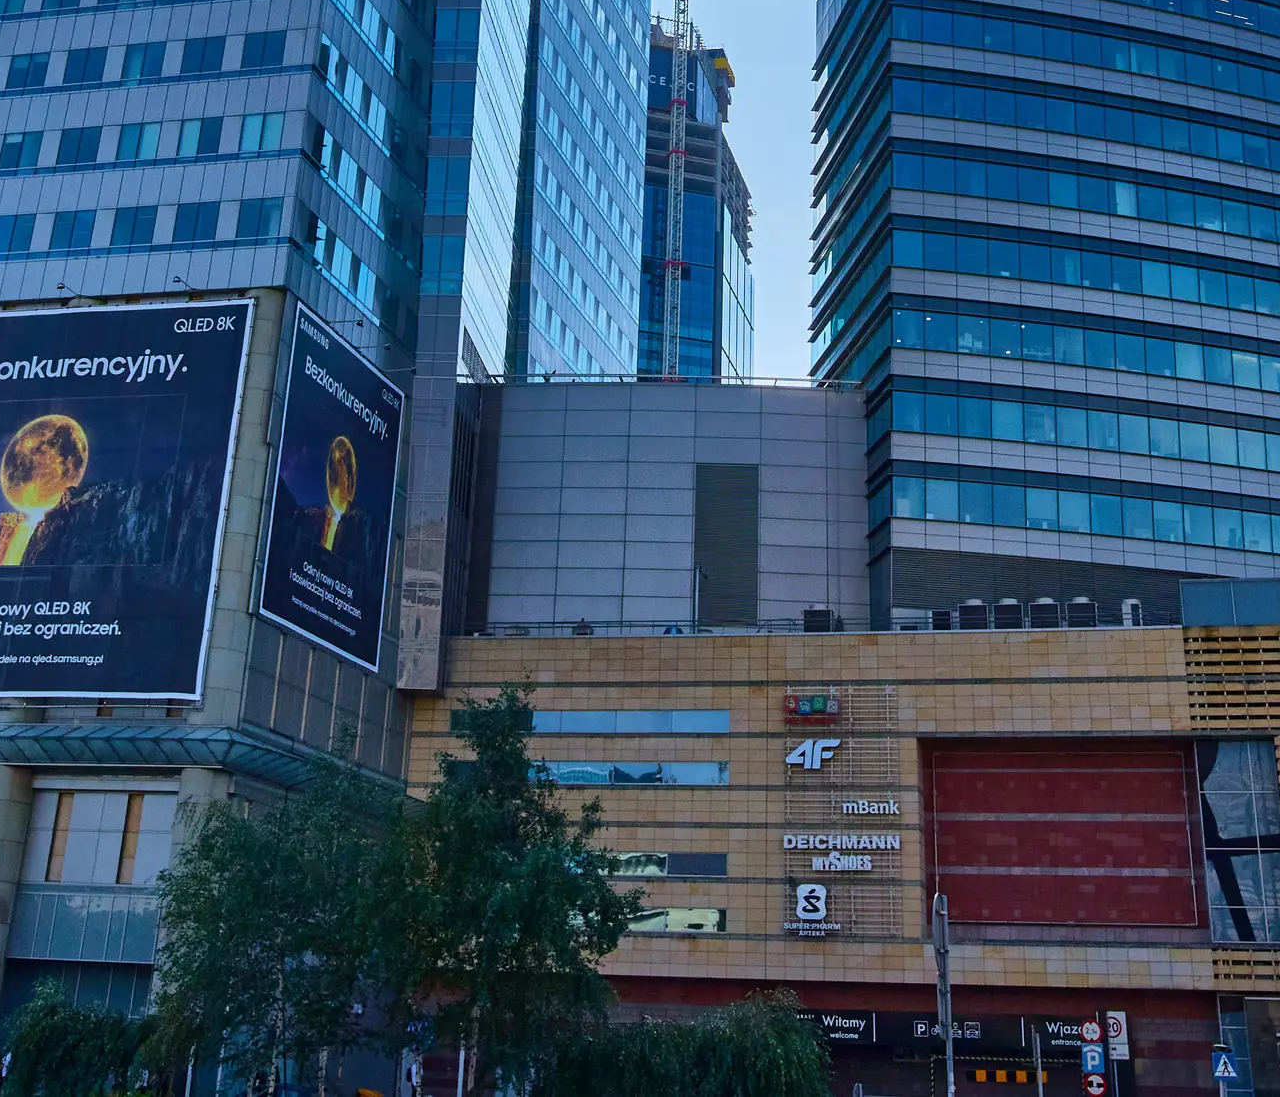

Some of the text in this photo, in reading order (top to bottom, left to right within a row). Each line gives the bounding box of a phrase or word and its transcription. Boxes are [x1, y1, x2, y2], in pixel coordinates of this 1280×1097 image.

[173, 316, 237, 334] QLED 8K
[299, 317, 330, 350] SAMSUNG
[304, 355, 388, 441] Bezkonkurencyjny.
[33, 601, 70, 616] QLED
[72, 601, 92, 615] 8K
[3, 621, 32, 636] bez
[34, 620, 122, 639] ograniczeń.
[19, 656, 31, 664] na
[31, 654, 104, 666] qled.samsung.pl
[785, 738, 841, 770] 4F
[842, 799, 900, 814] mBank
[783, 834, 900, 849] DEICHMANN
[822, 1014, 866, 1031] Witamy
[830, 1031, 859, 1039] welcome
